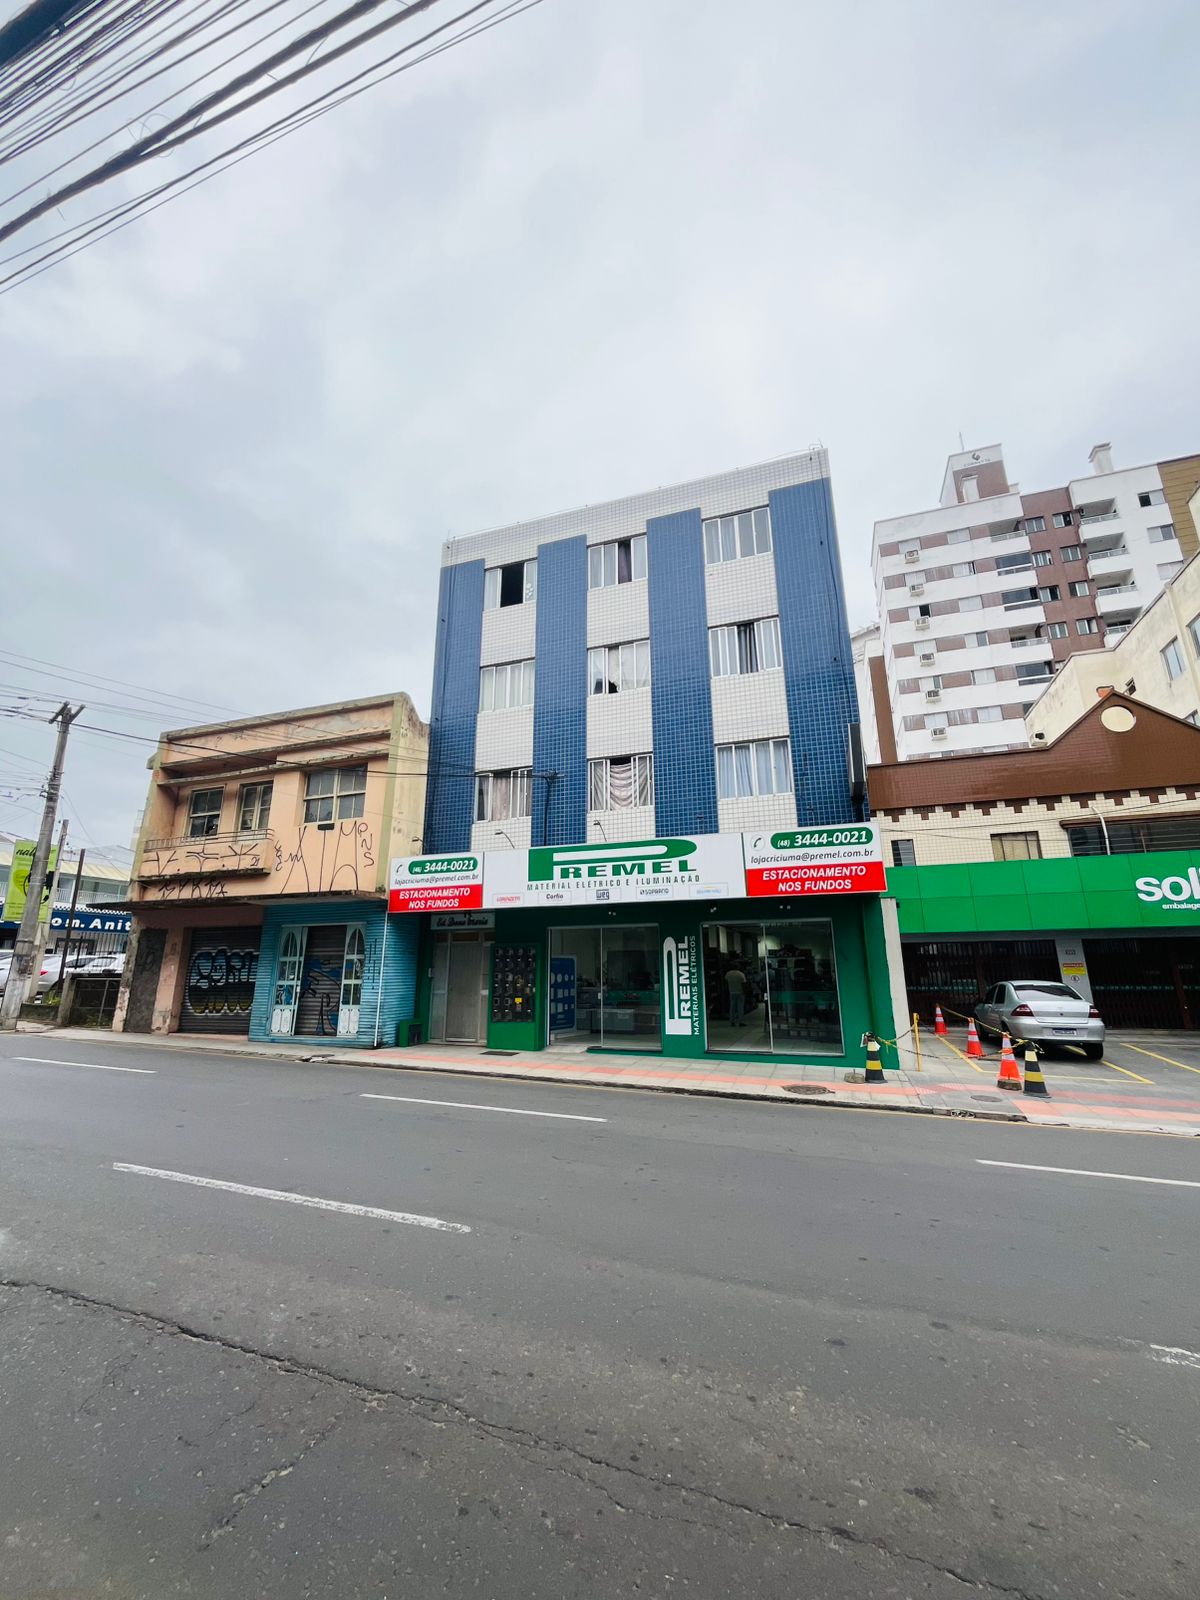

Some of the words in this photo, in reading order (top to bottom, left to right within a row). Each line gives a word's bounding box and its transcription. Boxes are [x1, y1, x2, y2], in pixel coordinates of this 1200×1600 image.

[777, 839, 791, 848] (48)
[794, 831, 868, 846] 3444-0021
[751, 848, 875, 865] lojacriciuma@premel.com.br
[424, 860, 474, 873] 3444-0021
[762, 866, 867, 881] ESTACIONAMENTO
[395, 873, 480, 885] lojacriciuma@premel.com.br
[527, 882, 571, 891] MATERIAL
[636, 874, 700, 886] ILUMINAÇÃO
[778, 881, 802, 892] NOS
[804, 879, 852, 891] FUNDOS
[1135, 867, 1200, 902] sol
[399, 887, 471, 900] ESTACIONAMENTO
[408, 900, 425, 909] NOS
[426, 898, 460, 909] FUNDOS
[692, 986, 700, 1035] MATERIAIS
